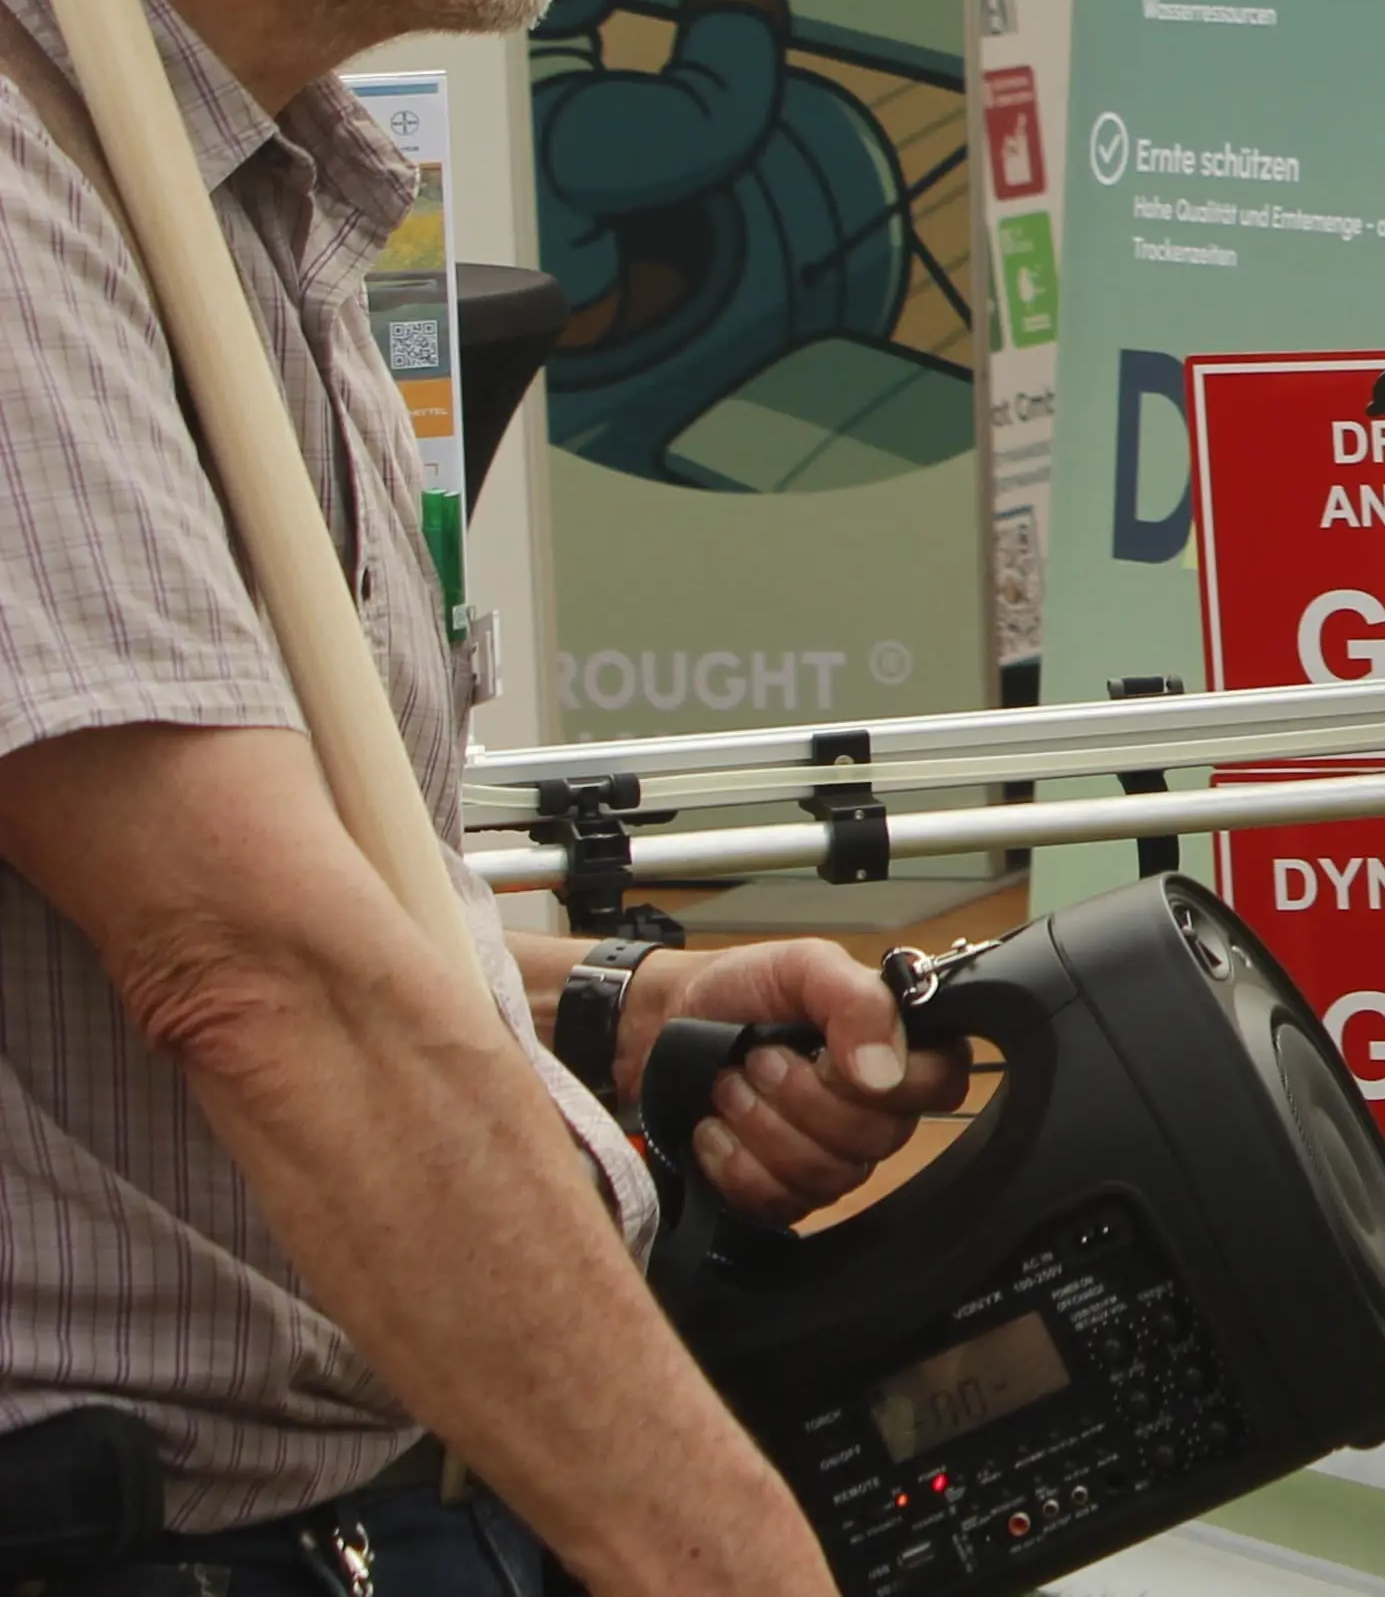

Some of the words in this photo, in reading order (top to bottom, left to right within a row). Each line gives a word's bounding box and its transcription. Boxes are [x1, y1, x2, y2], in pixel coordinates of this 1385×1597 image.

[1136, 138, 1196, 175] Ernte
[1201, 140, 1300, 183] schützen
[1240, 202, 1271, 230] und
[556, 649, 846, 711] ROUGHT
